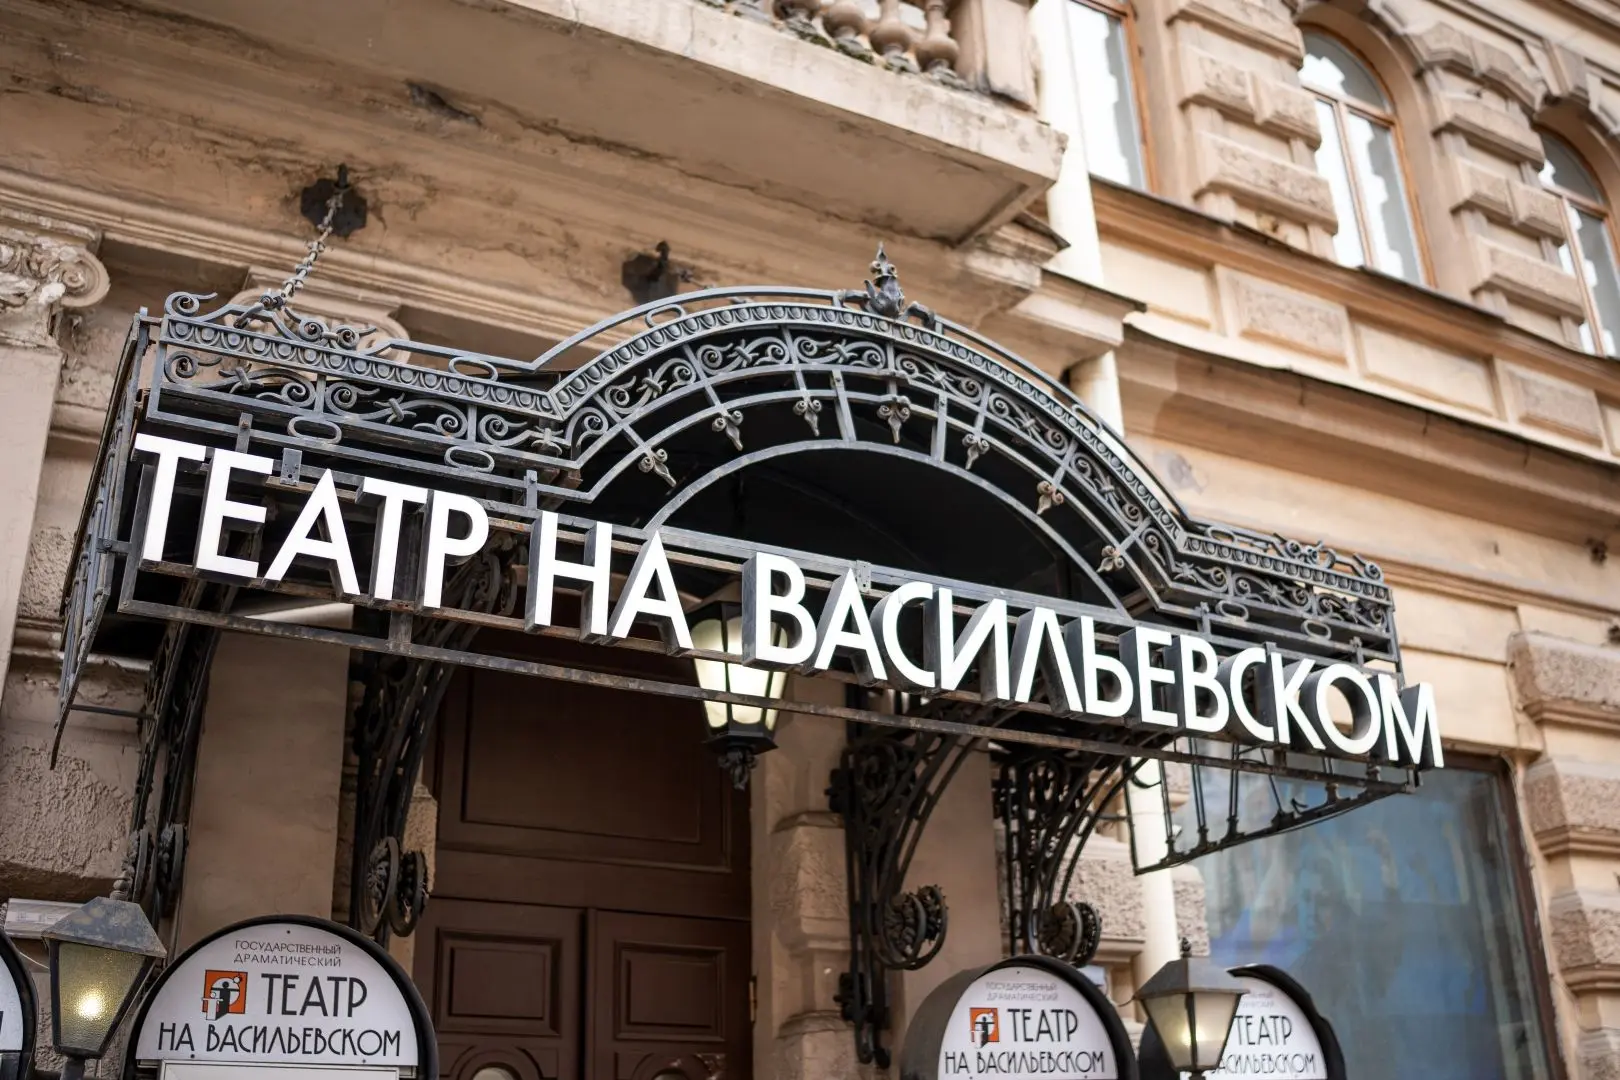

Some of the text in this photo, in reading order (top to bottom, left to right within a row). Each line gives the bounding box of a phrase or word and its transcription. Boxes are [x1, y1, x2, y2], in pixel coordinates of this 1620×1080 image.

[134, 433, 1444, 769] ТЕАТР НА ВАСИЛЬЕВСКОМ
[233, 953, 342, 968] ДРАМАТИЧЕСКИЙ
[235, 940, 342, 955] ГОСУДАРСТВЕННЫЙ
[261, 973, 368, 1018] ТЕАТР
[157, 1022, 401, 1057] НА ВАСИЛЬЕВСКОМ
[1007, 1008, 1079, 1042] ТЕАТР
[1234, 1015, 1293, 1046] ТЕАТР
[945, 1051, 1105, 1075] НА ВАСИЛЬЕВСКОМ
[1212, 1053, 1317, 1075] АСИЛЬЕВСКОМ
